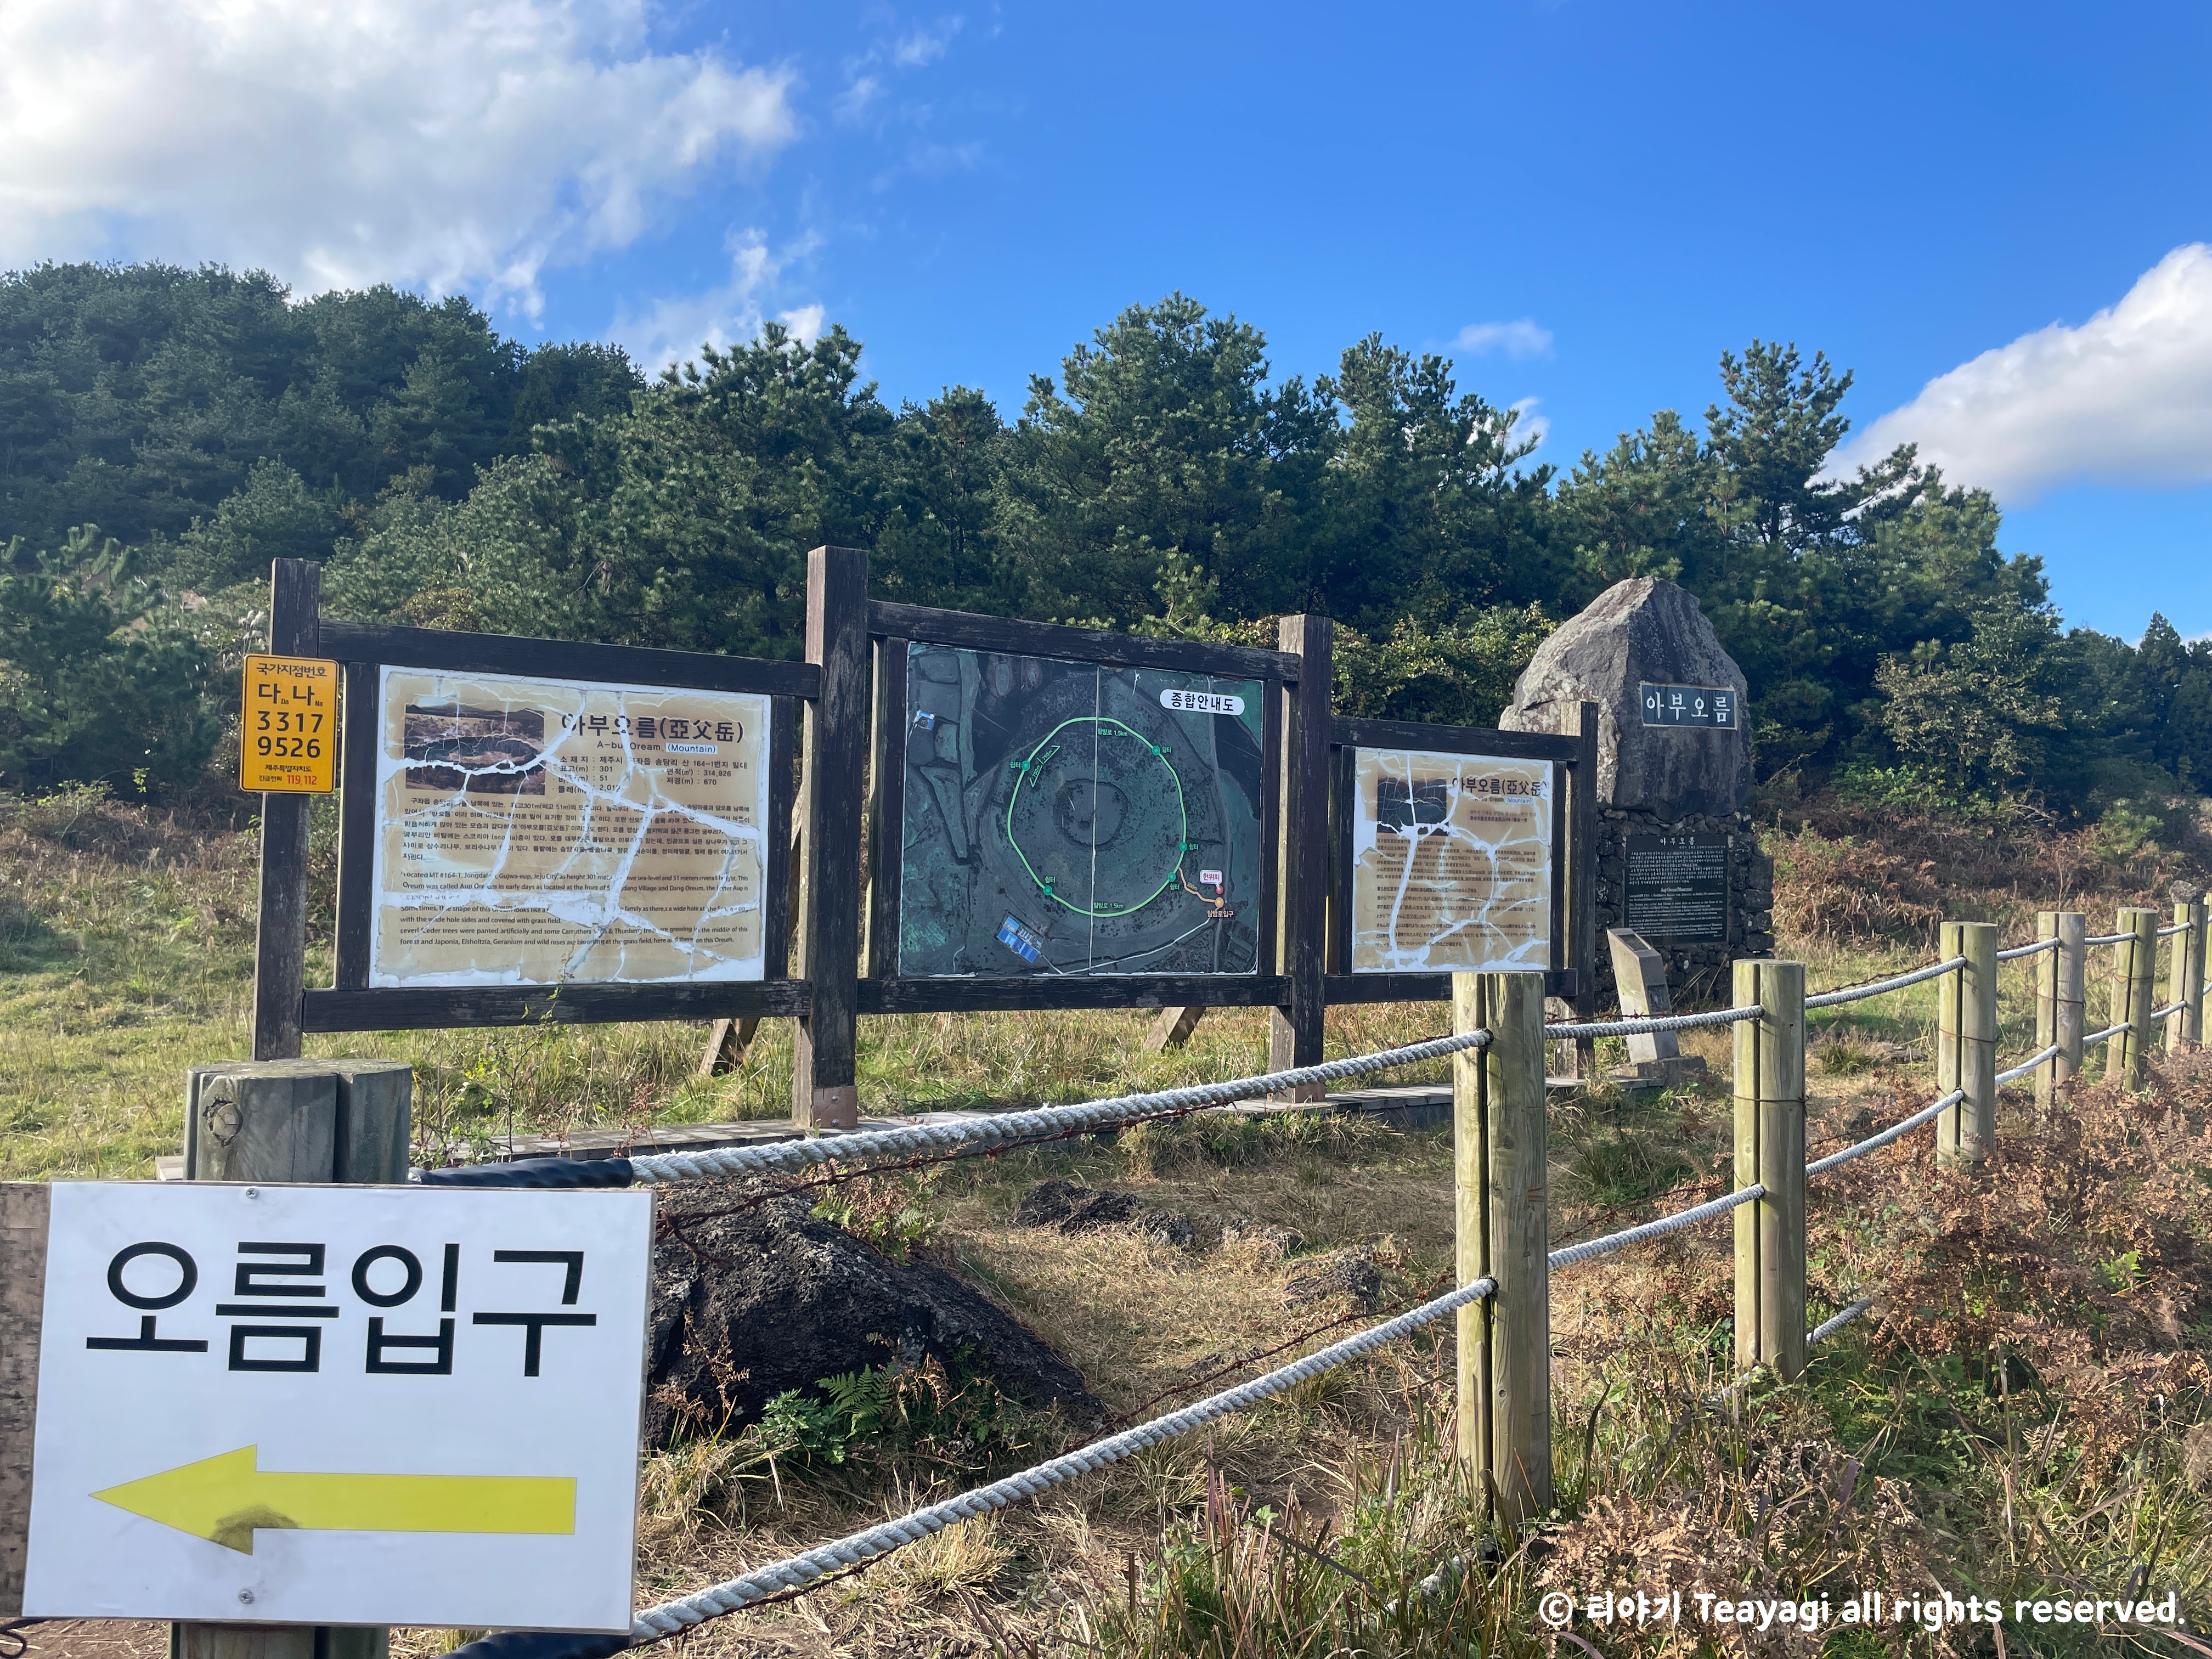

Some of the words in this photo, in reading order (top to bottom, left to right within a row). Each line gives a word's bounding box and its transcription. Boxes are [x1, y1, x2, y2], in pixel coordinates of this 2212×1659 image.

[257, 663, 327, 678] 국가지점번호
[258, 684, 281, 704] 다
[293, 685, 315, 706] 나
[1171, 692, 1233, 712] 종합안내도
[257, 710, 323, 733] 3317
[258, 736, 321, 758] 9526
[668, 743, 716, 753] (Mountain)
[1042, 749, 1052, 761] 750m
[600, 756, 623, 764] 제주시
[656, 758, 678, 766] 송당리
[86, 1240, 597, 1377] 오름입구
